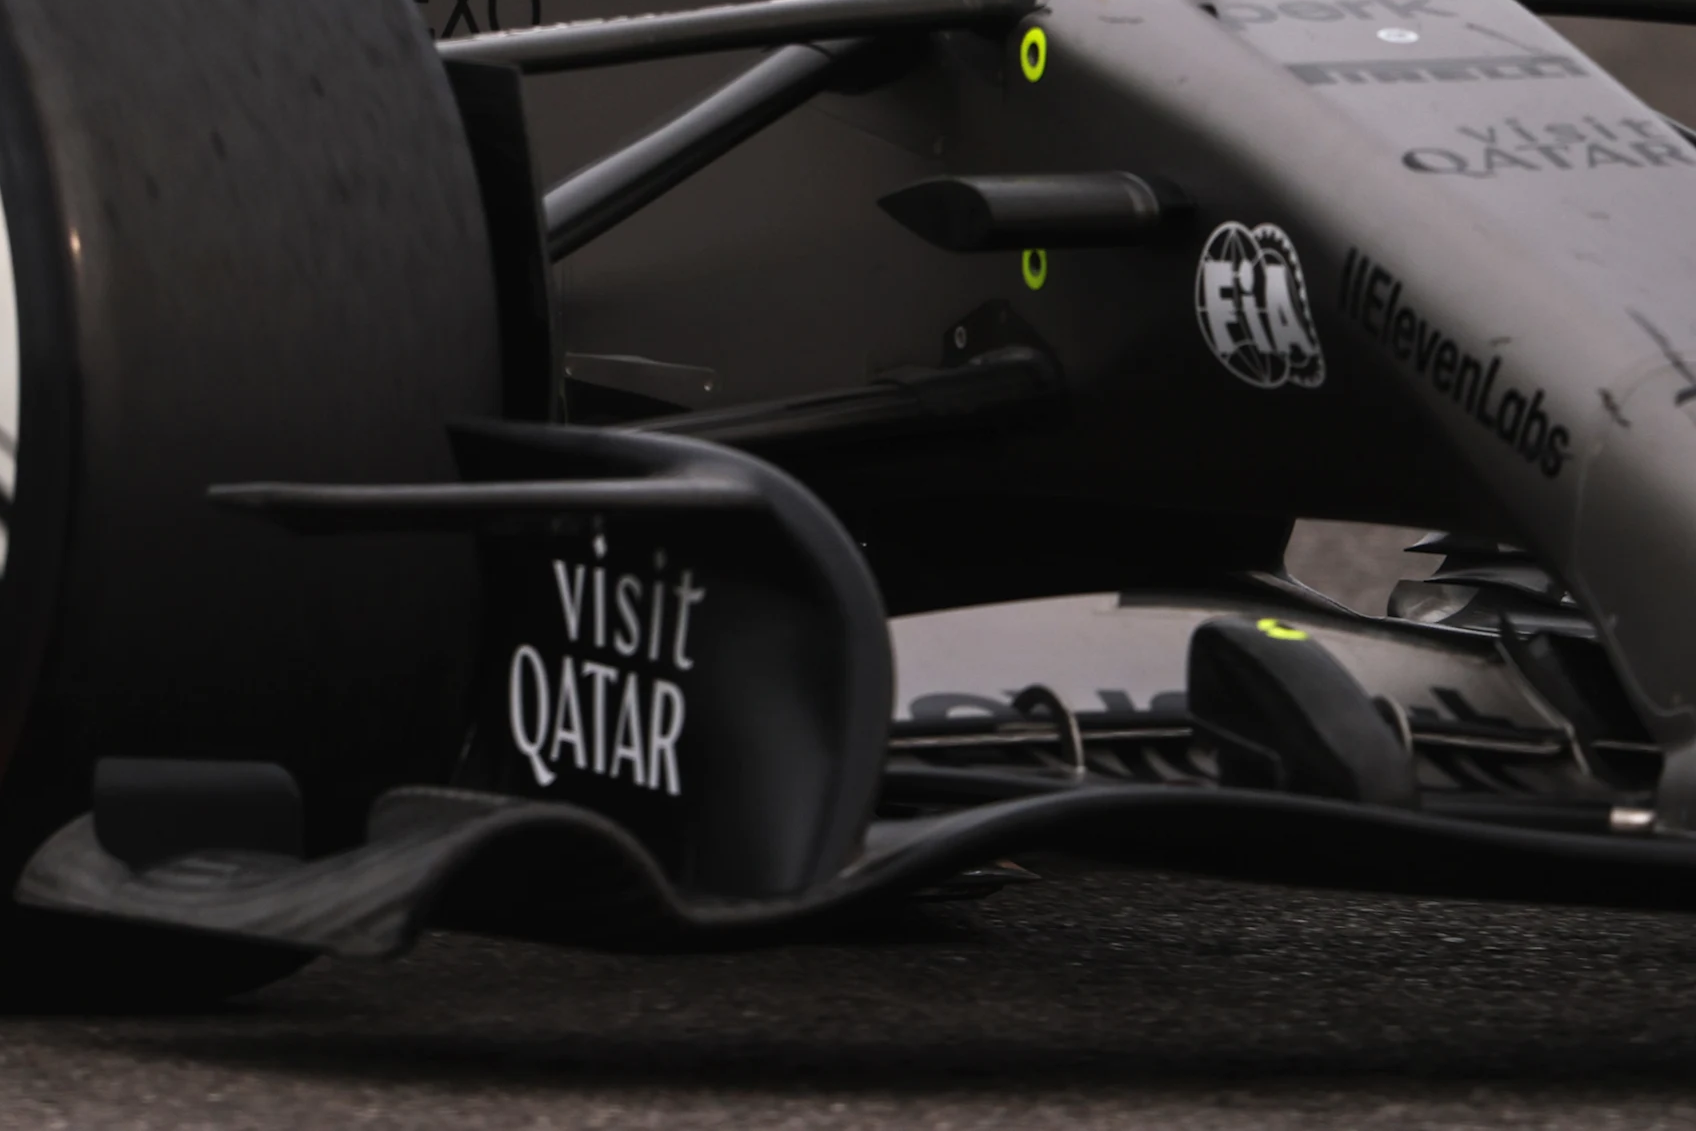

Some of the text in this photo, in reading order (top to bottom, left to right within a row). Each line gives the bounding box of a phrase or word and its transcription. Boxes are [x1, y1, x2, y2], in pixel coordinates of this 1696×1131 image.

[1286, 54, 1591, 85] PIRELLI
[1458, 115, 1669, 146] visit
[1402, 142, 1696, 178] QATAR
[551, 532, 707, 671] visit
[508, 642, 687, 797] QATAR
